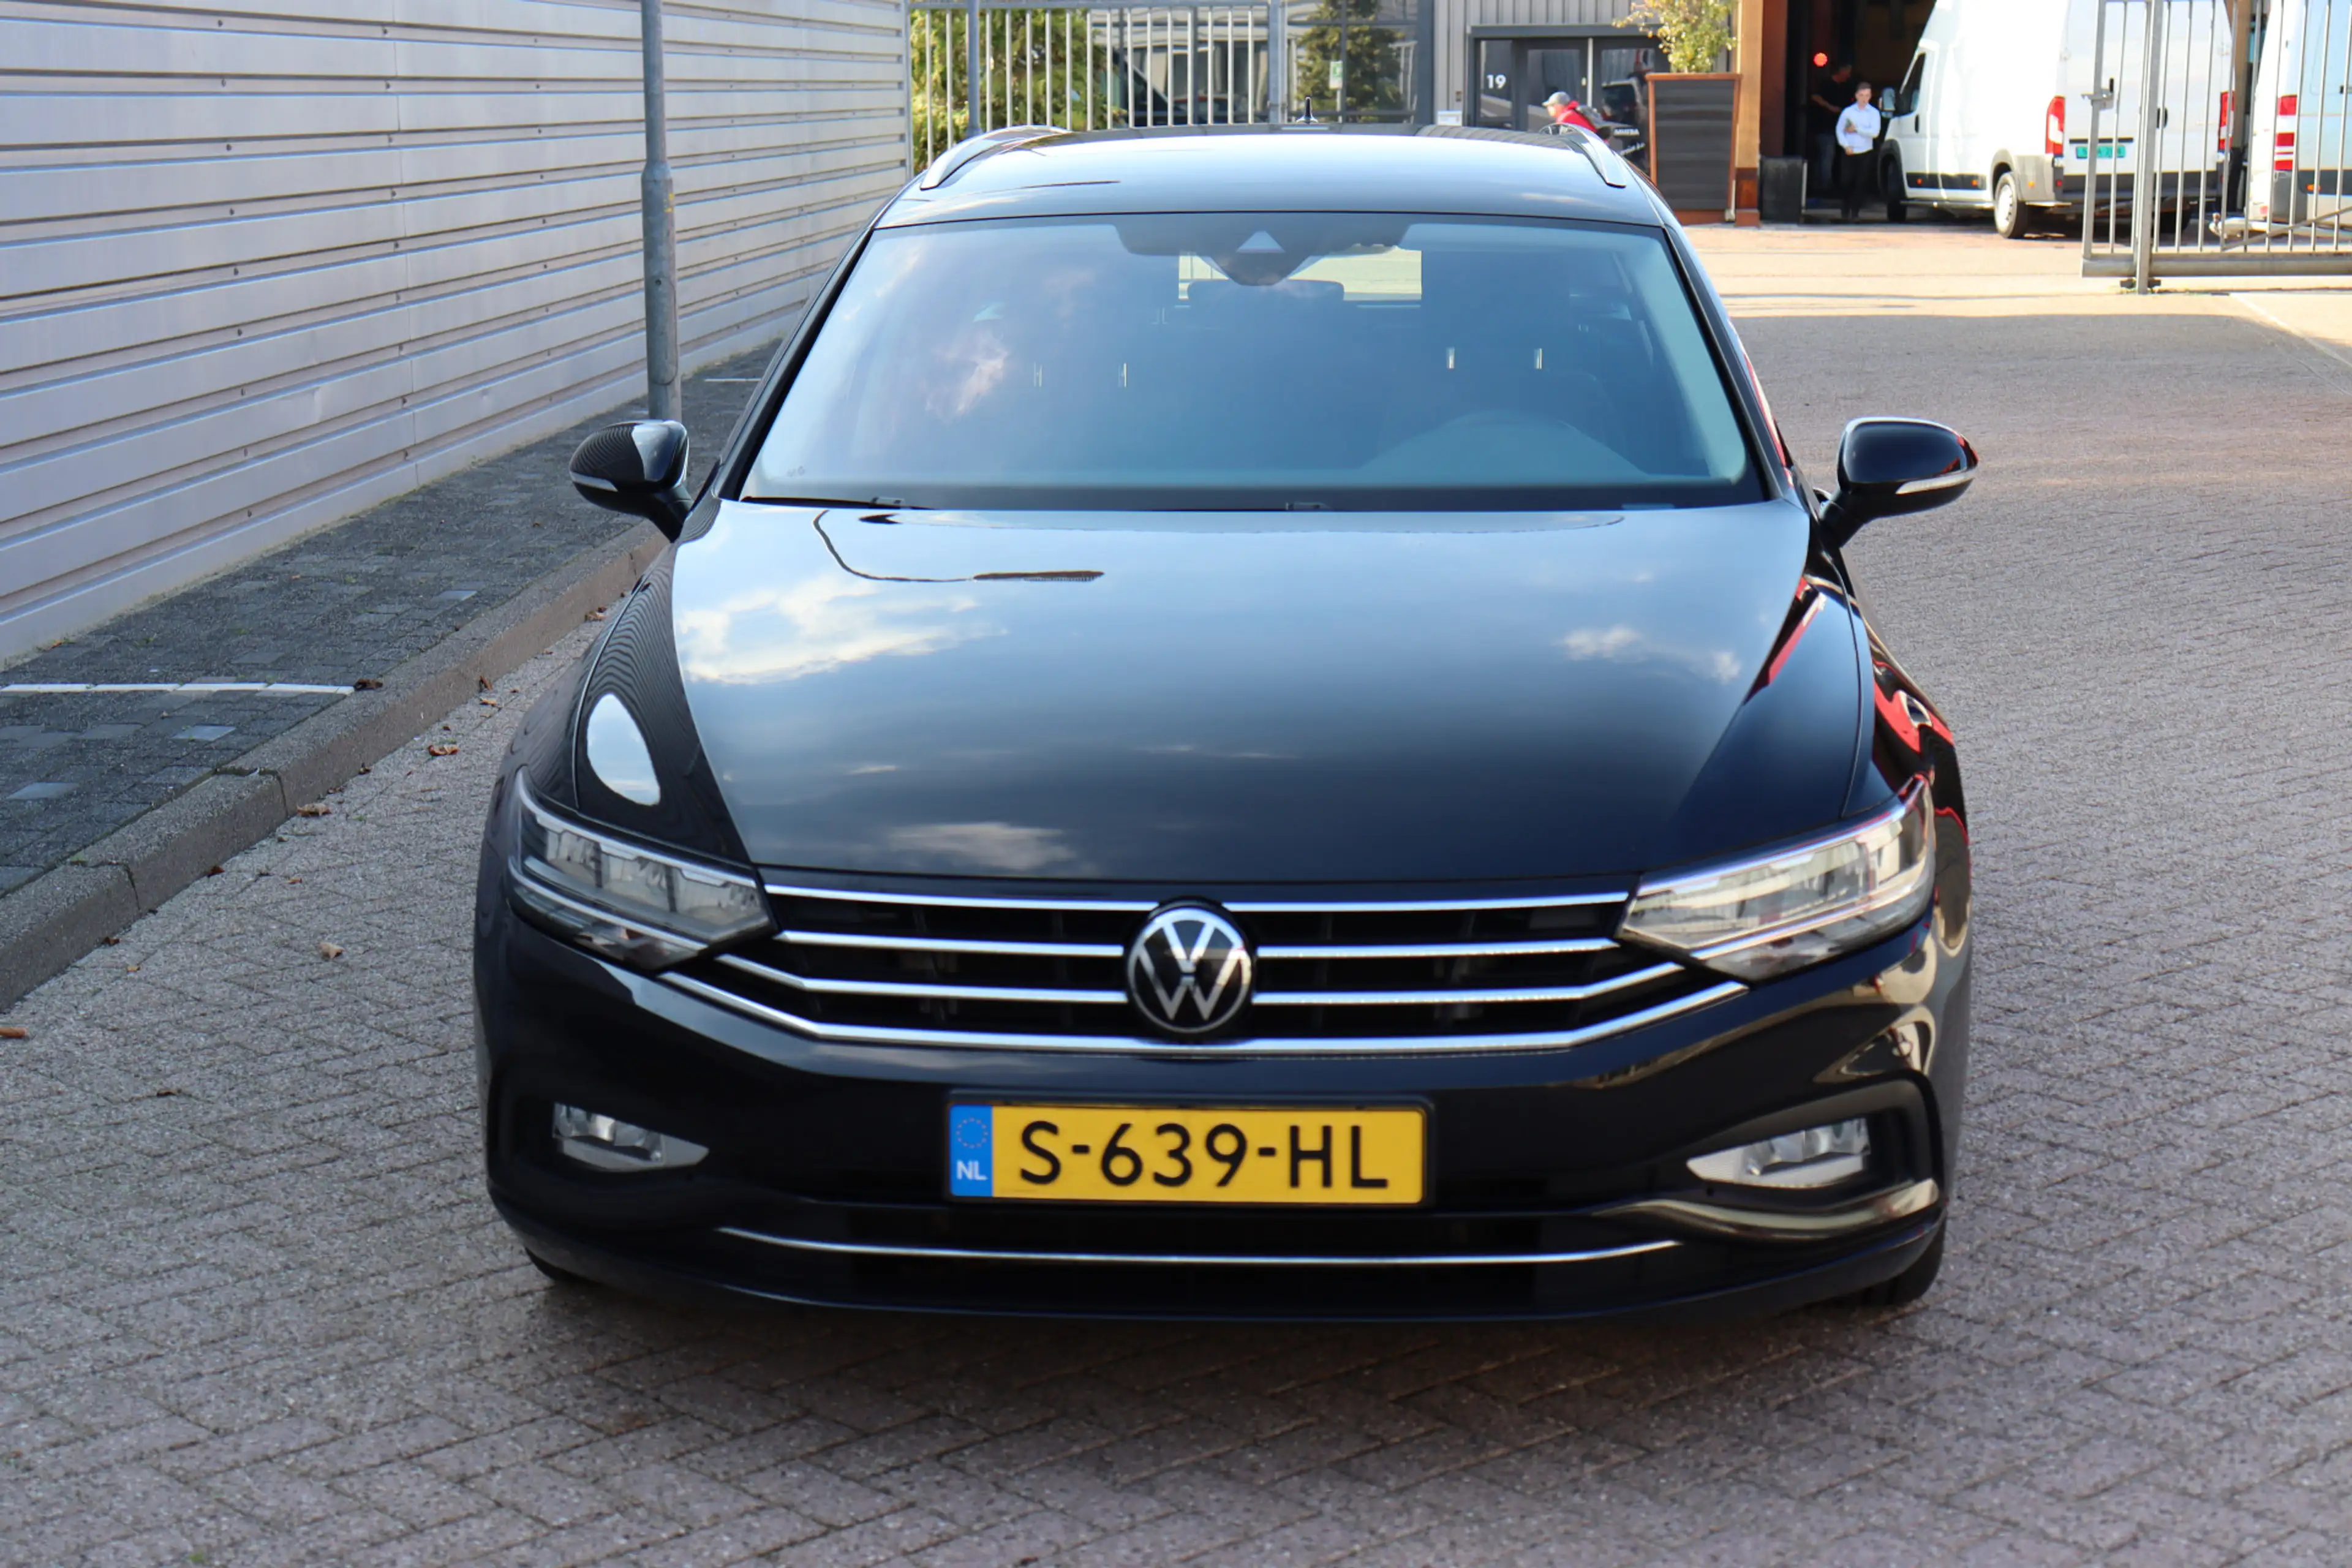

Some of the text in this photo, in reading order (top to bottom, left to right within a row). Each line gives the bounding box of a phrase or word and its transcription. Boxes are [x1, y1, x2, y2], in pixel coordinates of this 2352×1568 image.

[1487, 74, 1507, 89] 19
[1020, 1120, 1389, 1188] S-639-HL
[956, 1159, 989, 1181] NL
